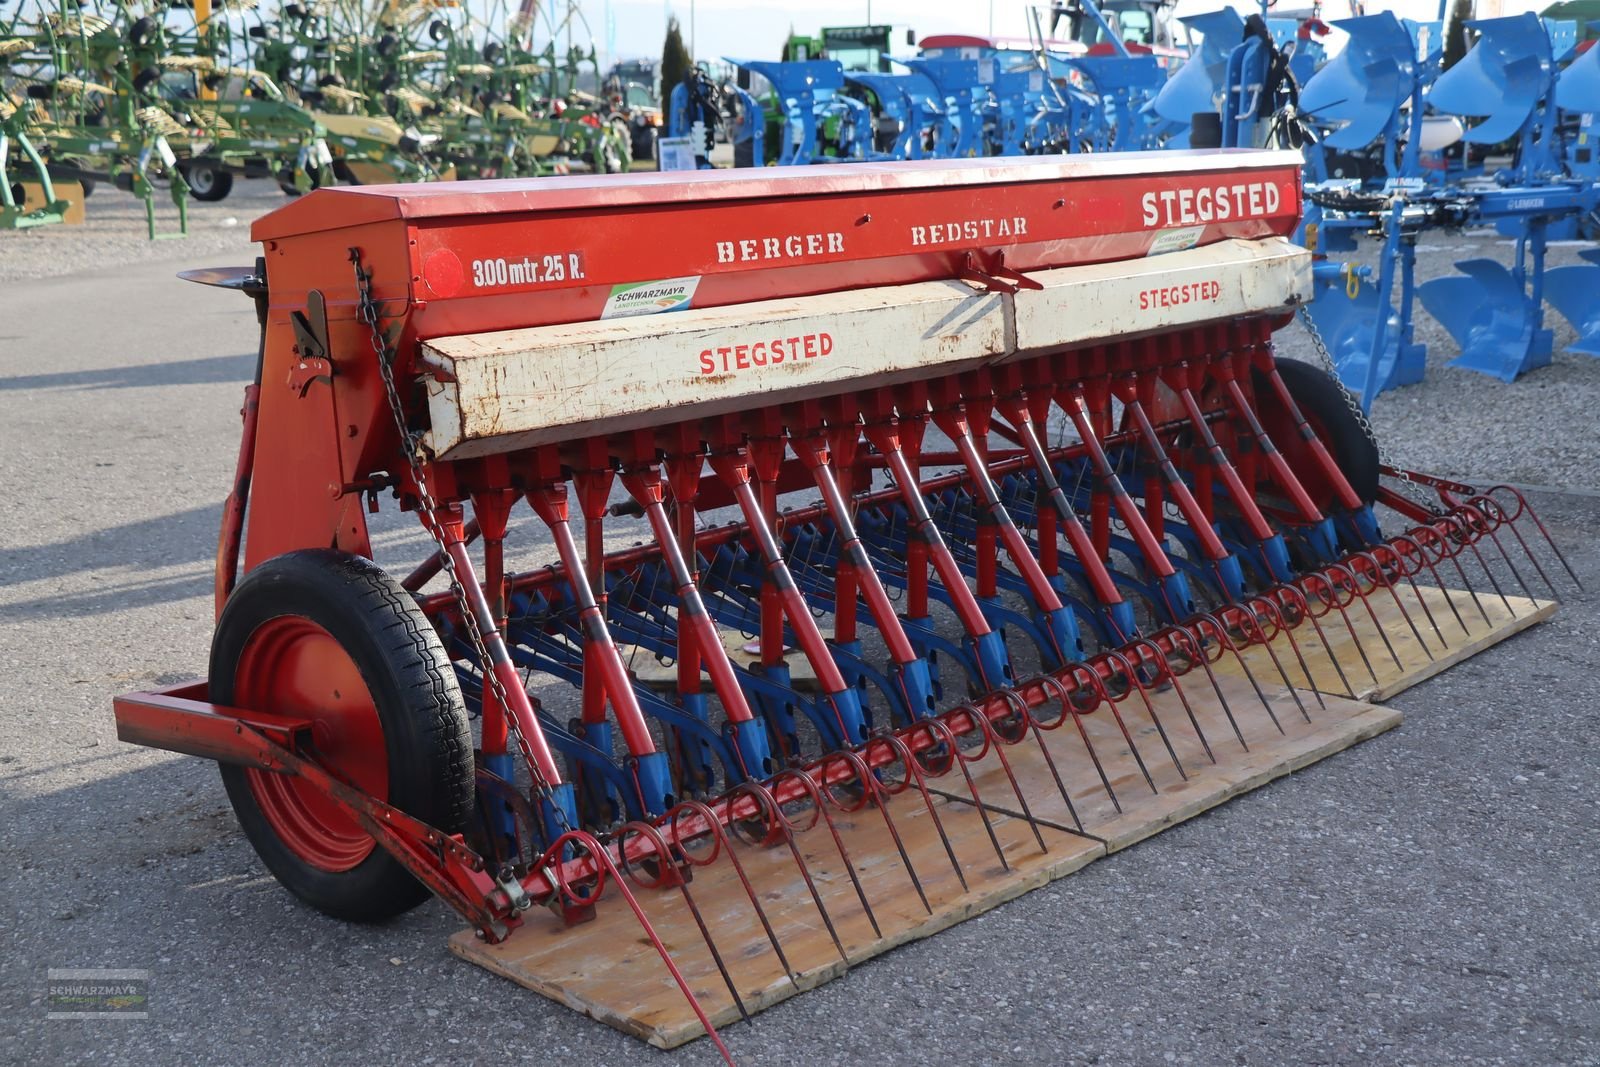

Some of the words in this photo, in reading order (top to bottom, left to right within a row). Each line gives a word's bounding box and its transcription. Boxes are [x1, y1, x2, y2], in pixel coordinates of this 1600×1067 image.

[1142, 181, 1280, 227] STEGSTED
[911, 217, 1028, 246] REDSTAR
[716, 232, 845, 264] BERGER
[615, 286, 686, 303] SCHWARZMAYR
[1139, 281, 1220, 311] STEGSTED
[699, 333, 833, 375] STEGSTED
